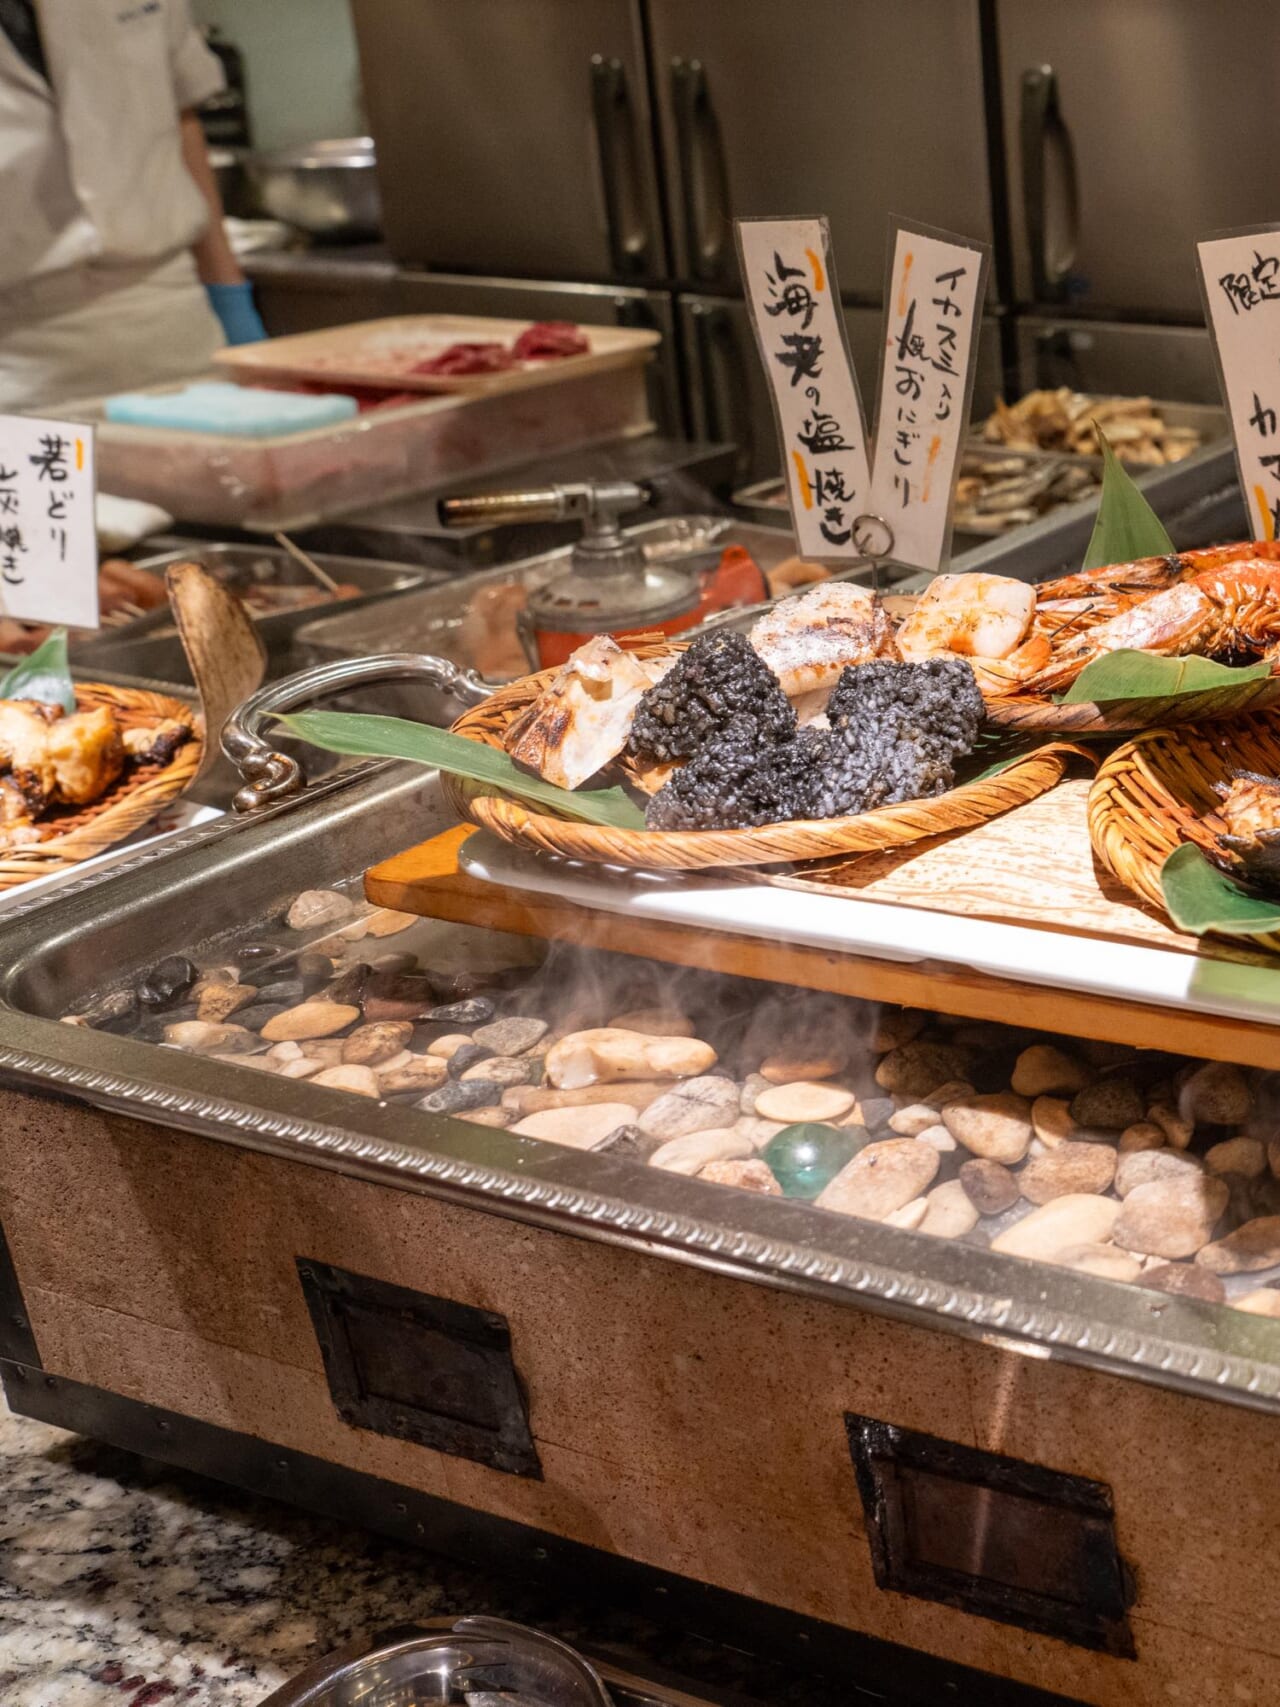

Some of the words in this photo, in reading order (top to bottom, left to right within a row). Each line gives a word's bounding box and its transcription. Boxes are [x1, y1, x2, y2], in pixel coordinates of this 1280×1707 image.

[763, 250, 855, 546] 海老の塩焼き
[895, 299, 926, 509] 焼おにぎり
[931, 267, 967, 421] イカスミ入り
[29, 434, 74, 561] 若どり
